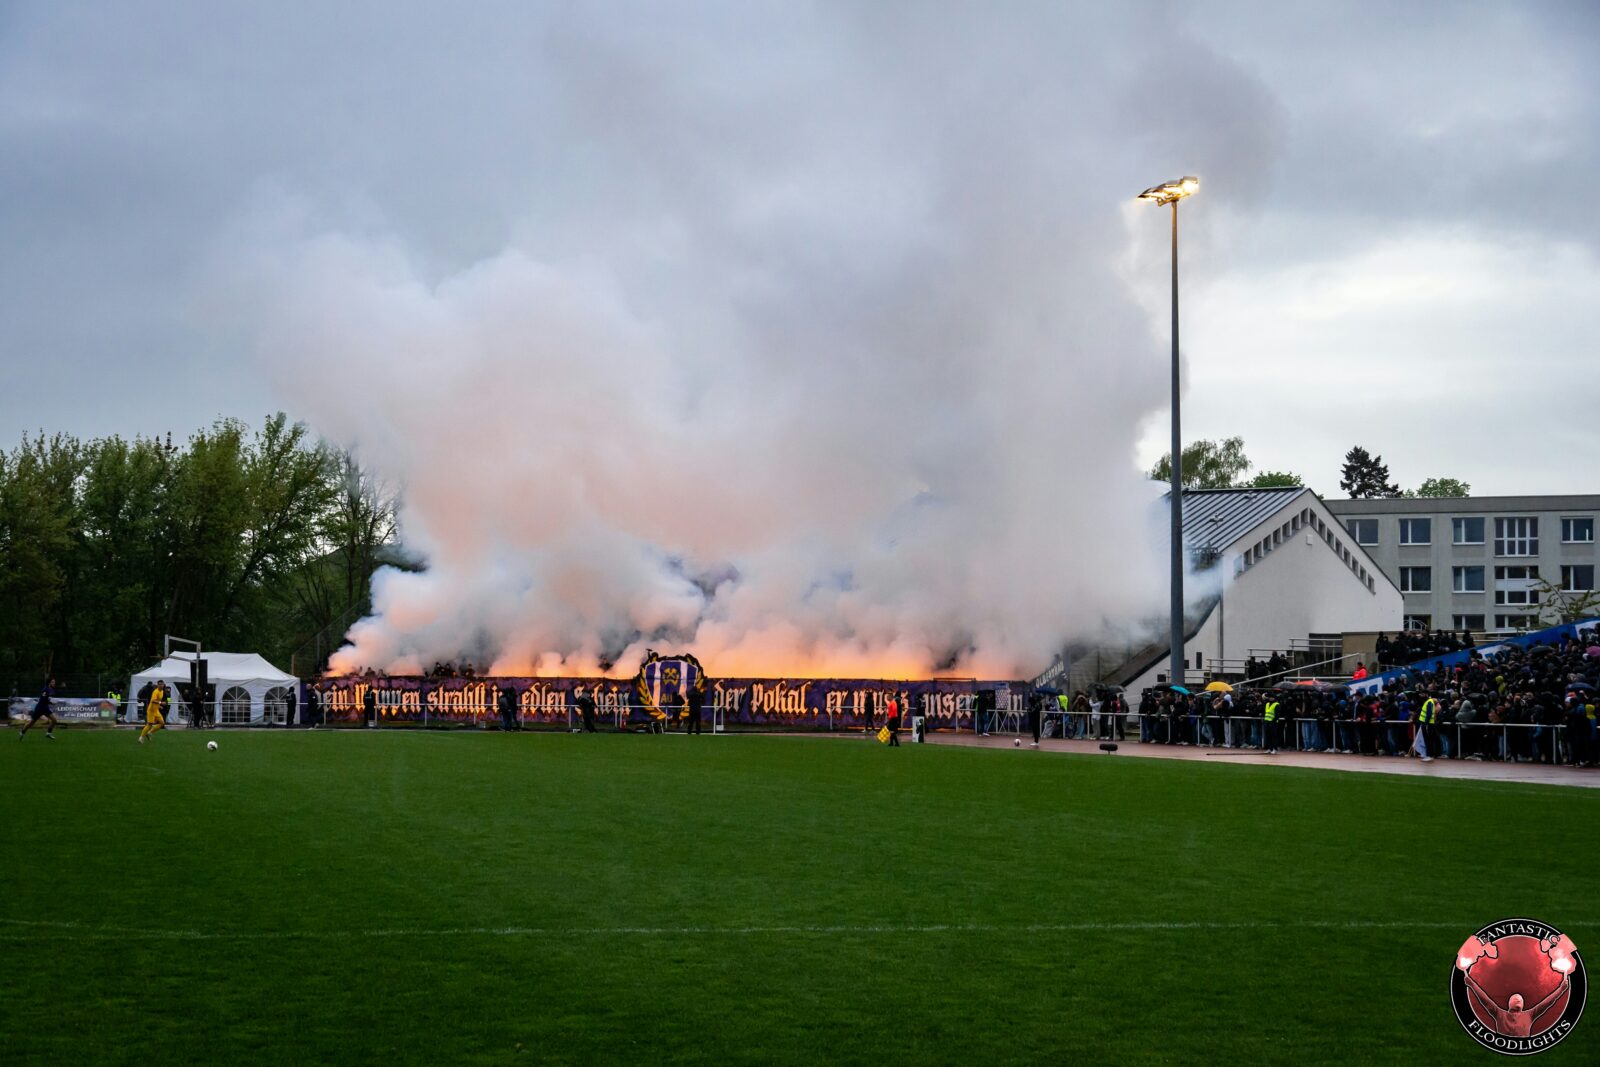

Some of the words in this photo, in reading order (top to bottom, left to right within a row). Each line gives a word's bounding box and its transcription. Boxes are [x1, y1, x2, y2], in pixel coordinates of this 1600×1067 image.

[426, 681, 488, 715] strahlt
[521, 681, 567, 716] edlen
[573, 682, 632, 717] Shein
[713, 679, 747, 713] der
[825, 689, 849, 718] er
[920, 690, 978, 720] unser
